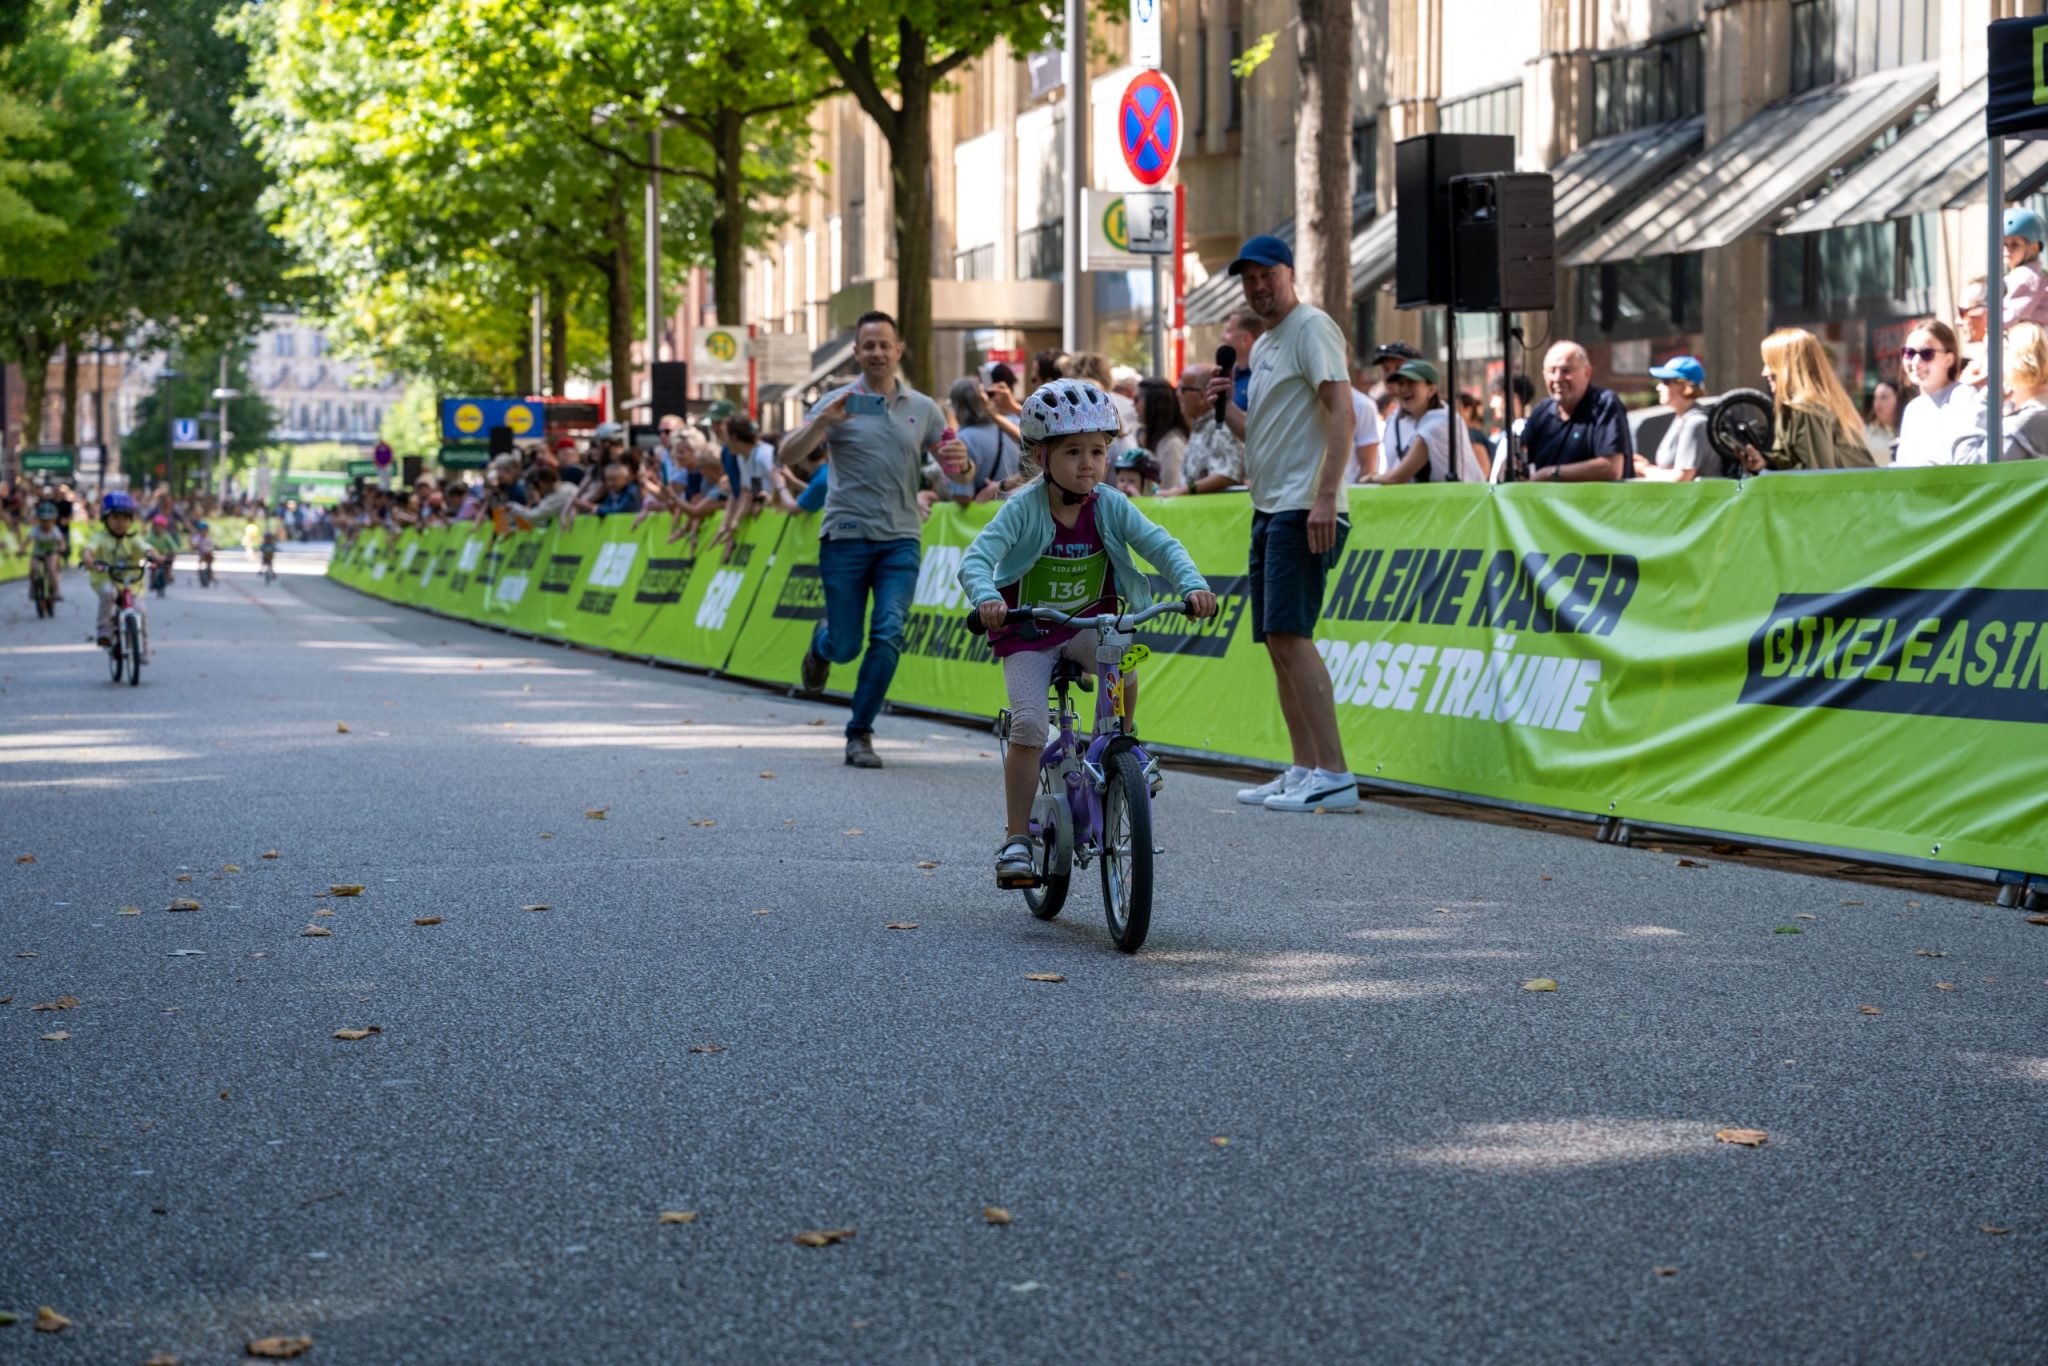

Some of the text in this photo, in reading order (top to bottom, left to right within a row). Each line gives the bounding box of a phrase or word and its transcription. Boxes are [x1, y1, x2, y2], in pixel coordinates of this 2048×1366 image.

[175, 420, 195, 441] U
[1048, 580, 1086, 599] 136
[1322, 549, 1640, 637] KLEINE RACER
[901, 612, 932, 655] OR
[1423, 633, 1602, 733] TRÄUME
